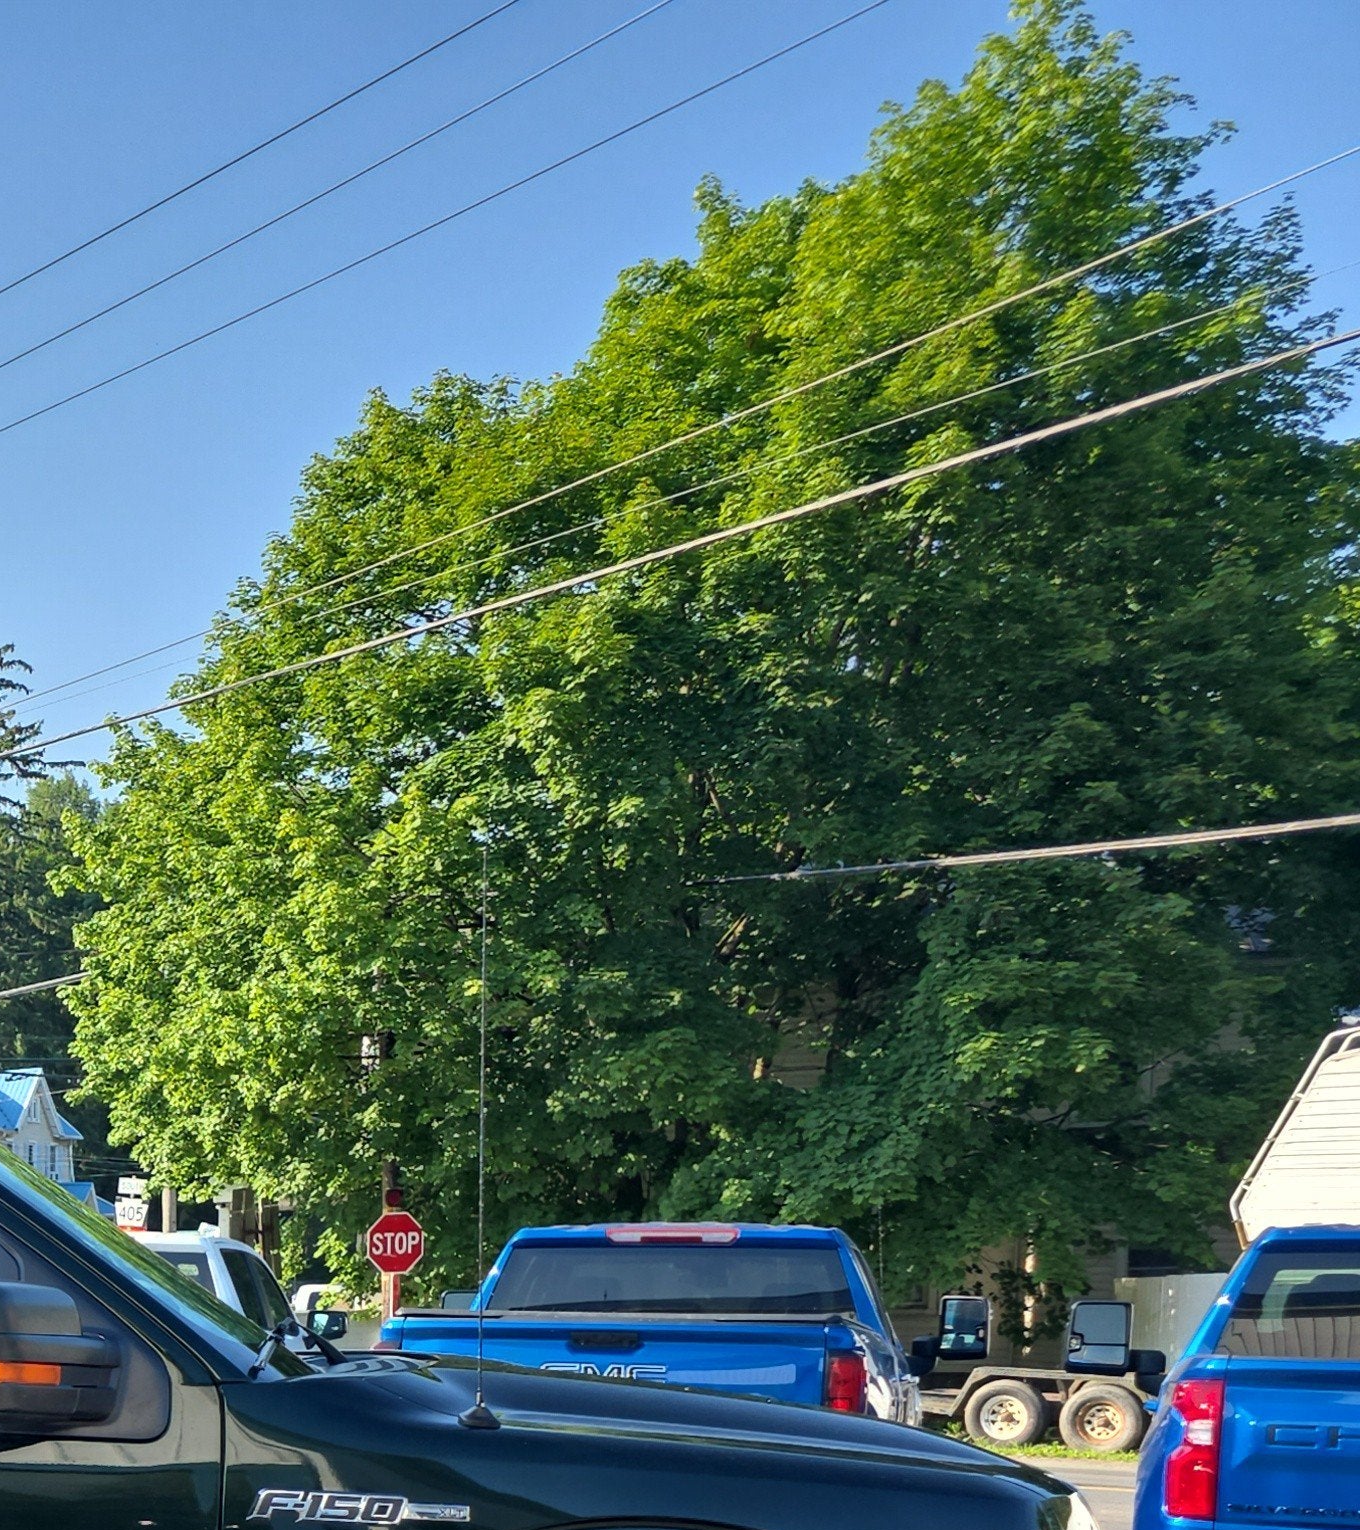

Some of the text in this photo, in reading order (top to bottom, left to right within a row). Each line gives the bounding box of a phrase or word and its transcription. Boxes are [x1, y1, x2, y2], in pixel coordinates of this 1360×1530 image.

[119, 1206, 143, 1222] 405
[371, 1231, 420, 1256] STOP
[245, 1487, 409, 1526] F-150
[438, 1506, 468, 1519] XLT
